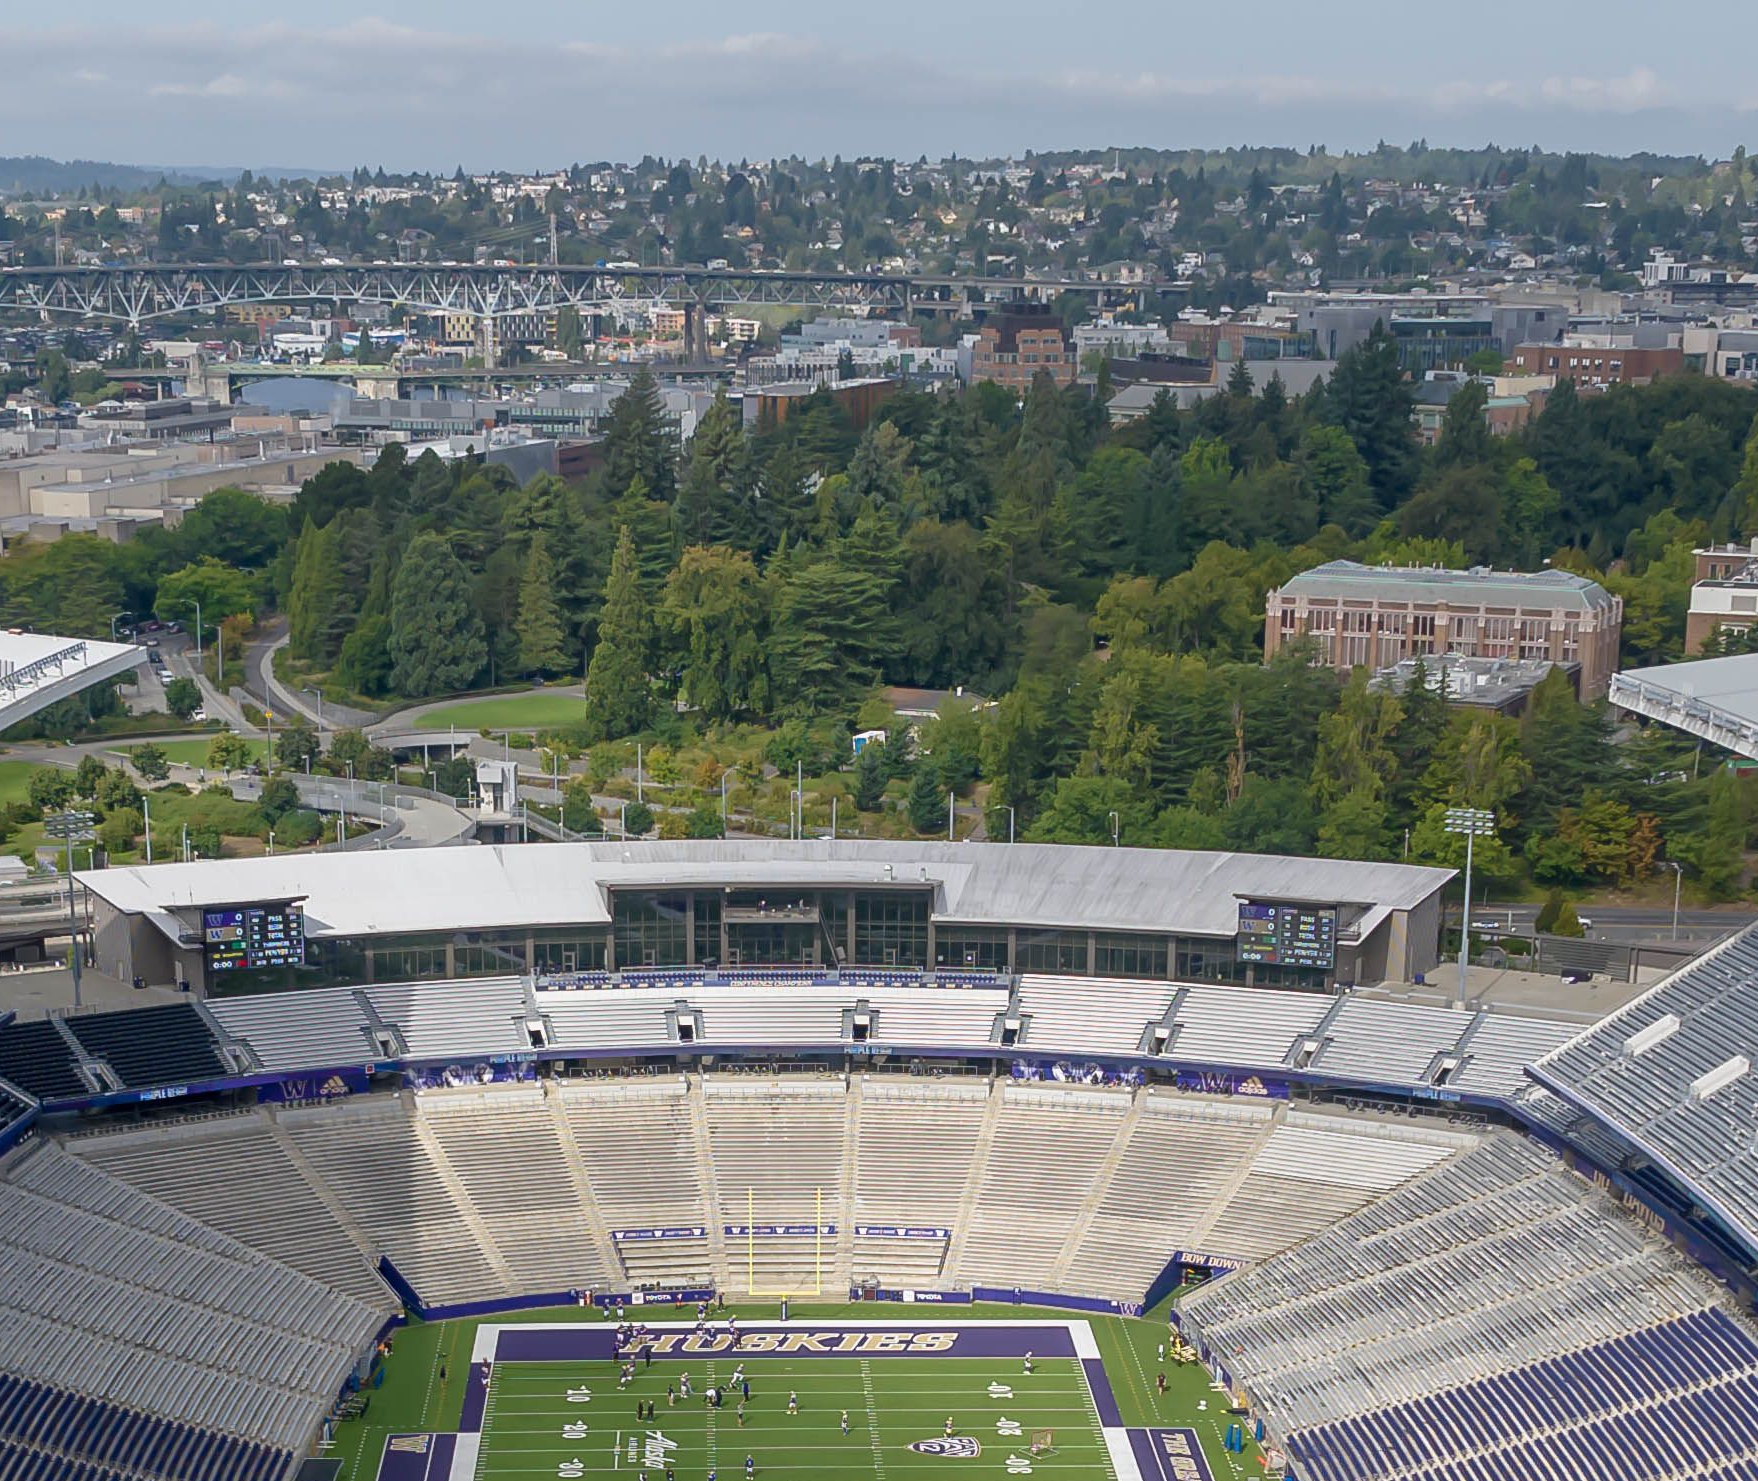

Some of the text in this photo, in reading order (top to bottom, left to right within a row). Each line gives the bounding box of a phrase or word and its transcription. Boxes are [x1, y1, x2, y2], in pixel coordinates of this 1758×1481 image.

[235, 913, 243, 921] 0
[210, 929, 223, 940] W
[236, 928, 243, 936] 0
[213, 961, 233, 969] 0:00
[279, 1079, 307, 1099] W
[1180, 1252, 1206, 1265] BOW
[1119, 1302, 1137, 1316] W
[619, 1332, 959, 1353] HUSKIES
[390, 1435, 429, 1454] W
